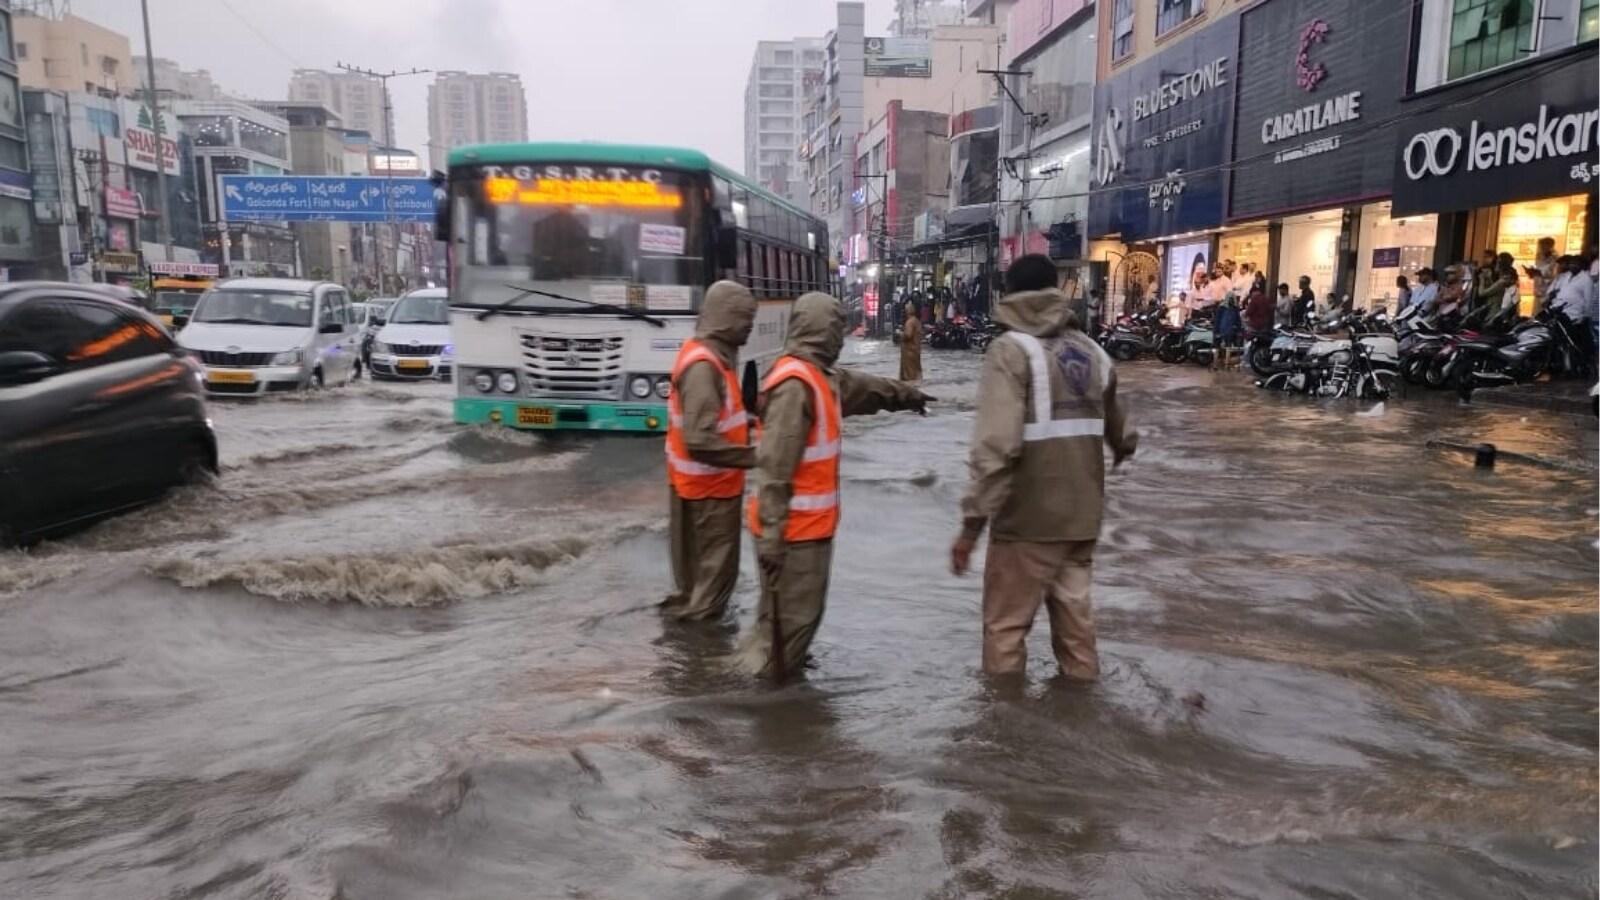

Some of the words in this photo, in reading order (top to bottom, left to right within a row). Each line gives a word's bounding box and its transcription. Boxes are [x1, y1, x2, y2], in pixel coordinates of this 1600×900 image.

[1133, 55, 1229, 121] BLUESTONE
[1261, 90, 1361, 145] CARATLANE
[1466, 103, 1600, 172] lenskar
[289, 198, 307, 207] Fort
[313, 198, 330, 207] Film
[333, 198, 359, 209] Nagar
